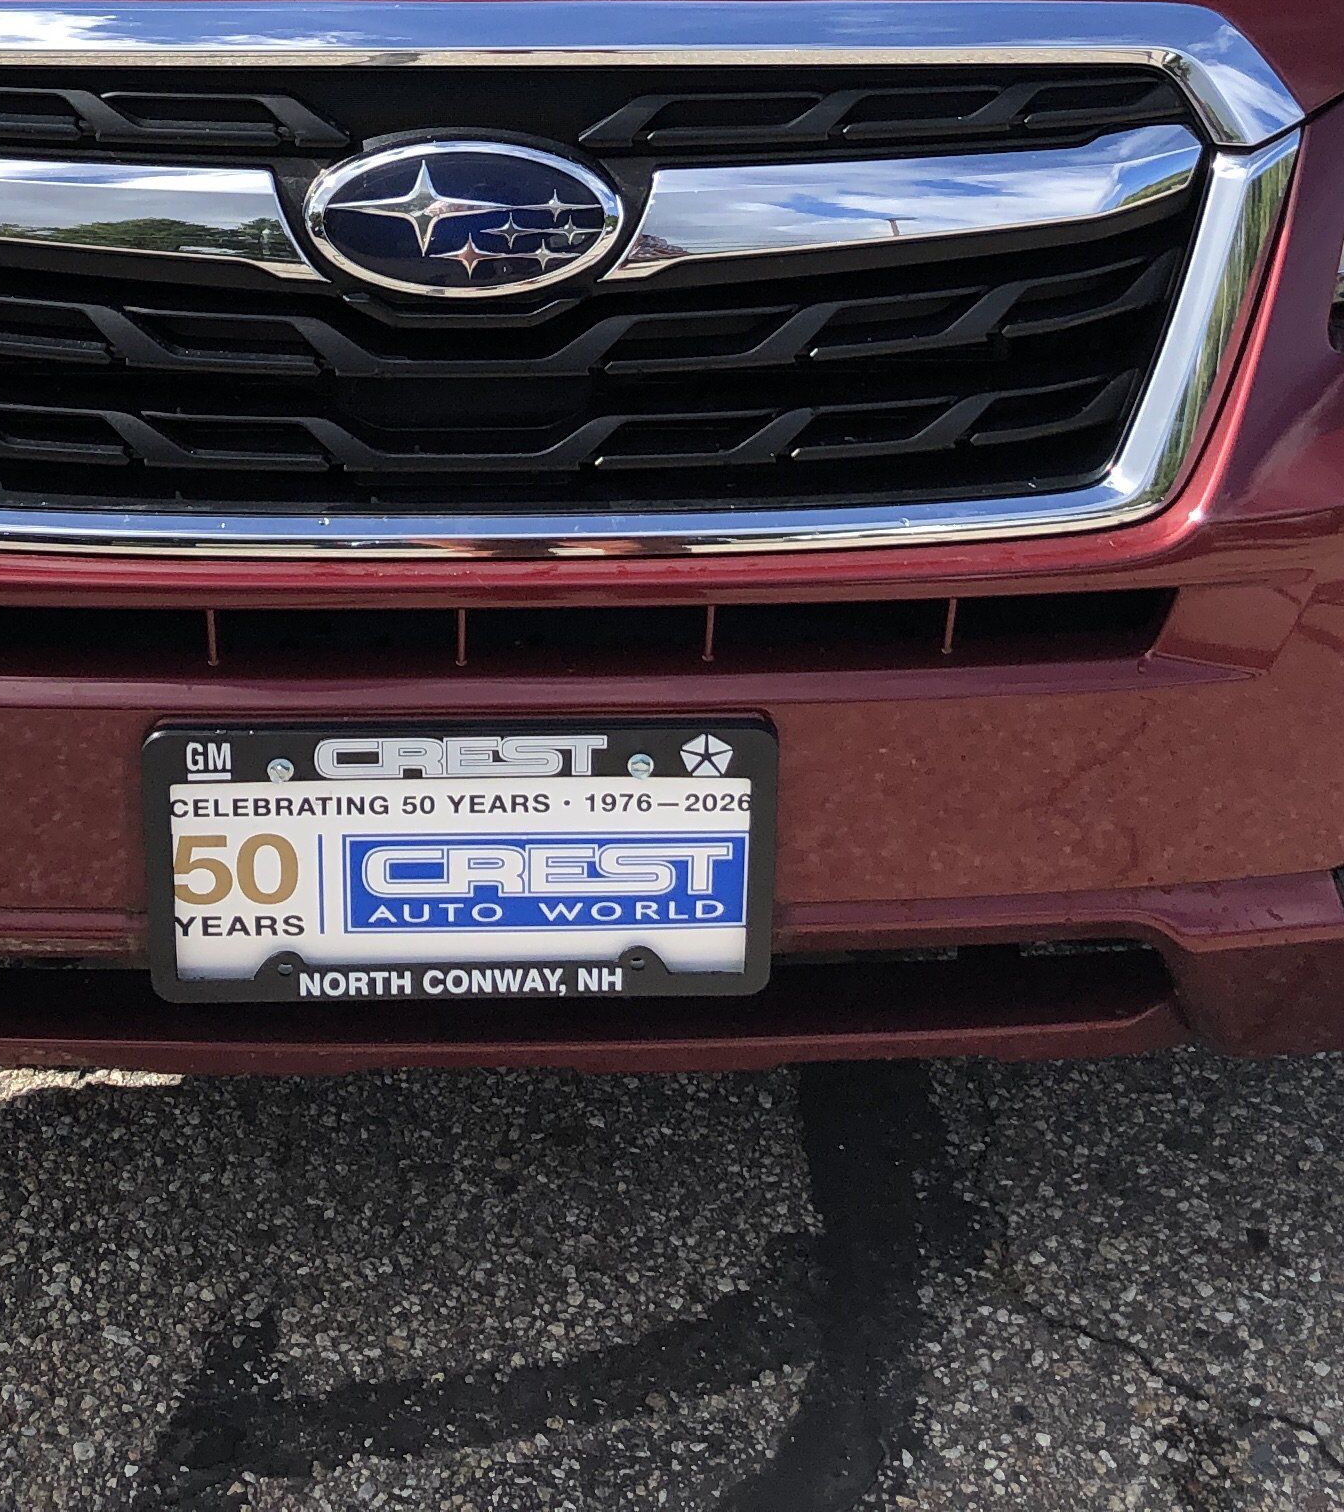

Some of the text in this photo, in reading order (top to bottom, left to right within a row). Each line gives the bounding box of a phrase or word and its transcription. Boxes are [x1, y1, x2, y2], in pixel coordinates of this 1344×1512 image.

[186, 741, 232, 773] GM
[314, 734, 608, 780] CREST
[171, 794, 389, 818] CELEBRATING
[402, 795, 436, 815] 50
[448, 793, 551, 814] YEARS
[174, 833, 299, 905] 50
[361, 842, 733, 899] CREST
[175, 914, 306, 938] YEARS
[367, 899, 725, 924] AUTO WORLD
[299, 967, 623, 997] NORTH CONWAY, NH
